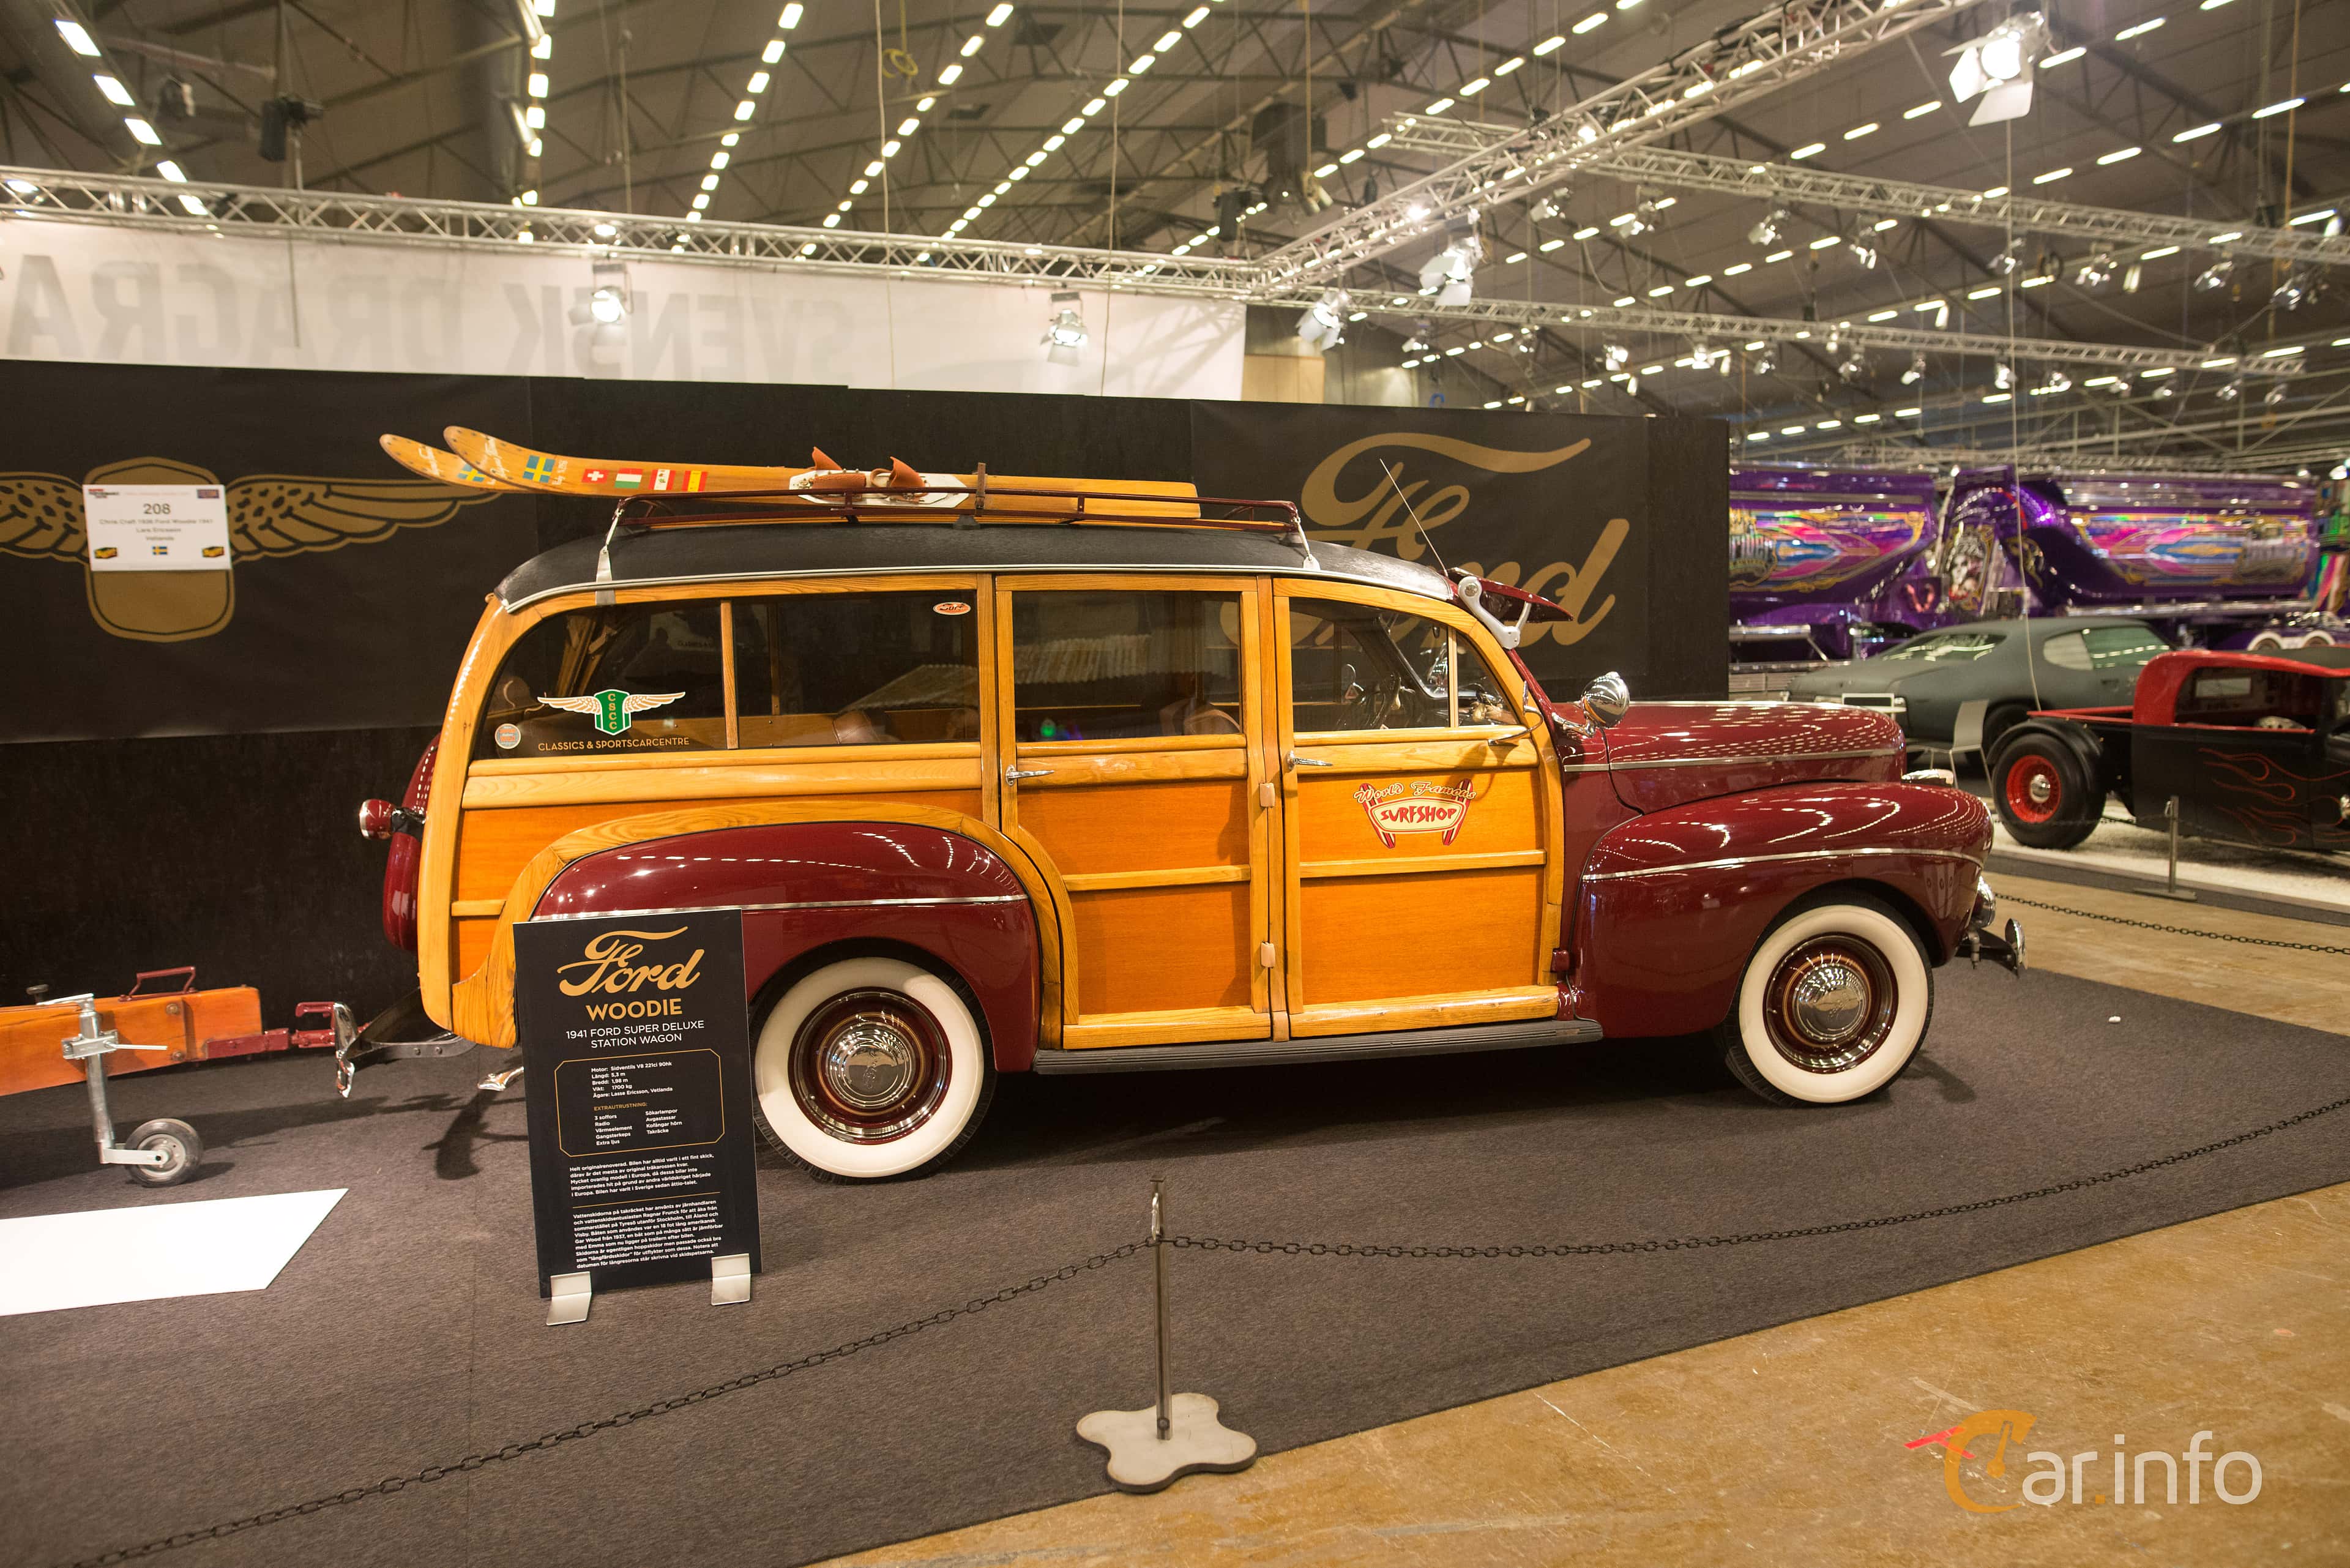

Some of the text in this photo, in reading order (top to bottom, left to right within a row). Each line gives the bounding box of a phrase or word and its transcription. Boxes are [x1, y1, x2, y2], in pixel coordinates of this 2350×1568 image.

[143, 504, 171, 514] 208
[607, 693, 617, 731] CSCC
[538, 737, 690, 751] CLASSICS & SPORTSCARCENTRE
[1353, 780, 1477, 804] World Famous
[1380, 805, 1457, 823] SURFSHOP
[557, 925, 704, 997] Ford
[585, 998, 682, 1021] WOODIE
[565, 1020, 704, 1039] 1941 FORD SUPER DELUXE
[591, 1032, 682, 1048] STATION WAGON
[594, 1102, 647, 1111] EXTRAUTRUSTNING:
